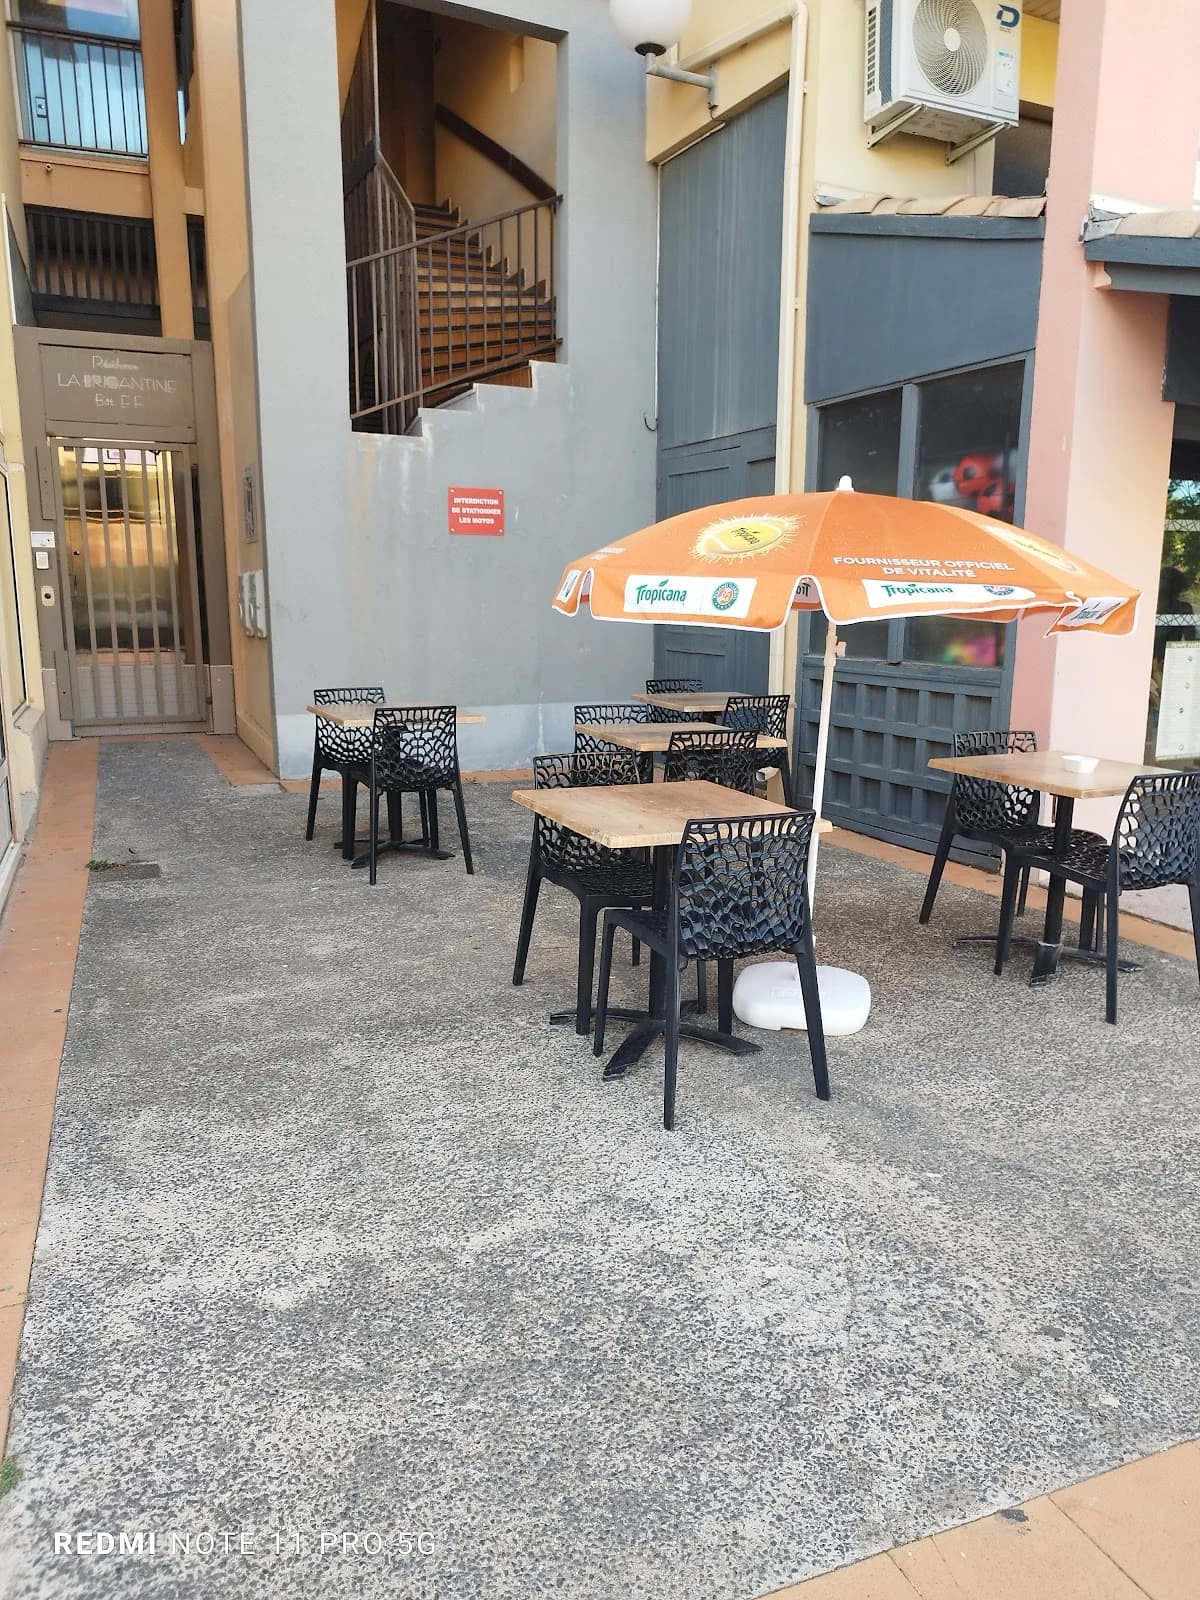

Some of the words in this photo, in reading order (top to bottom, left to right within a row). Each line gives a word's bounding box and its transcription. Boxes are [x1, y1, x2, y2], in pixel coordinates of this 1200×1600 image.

[57, 372, 81, 388] LA
[832, 556, 941, 568] FOURNISSEUR
[944, 559, 1016, 572] OFFICIEL
[882, 567, 905, 576] DE
[908, 567, 977, 578] VITALITÉ
[635, 582, 688, 605] Tropicana
[880, 584, 954, 598] Tropicana
